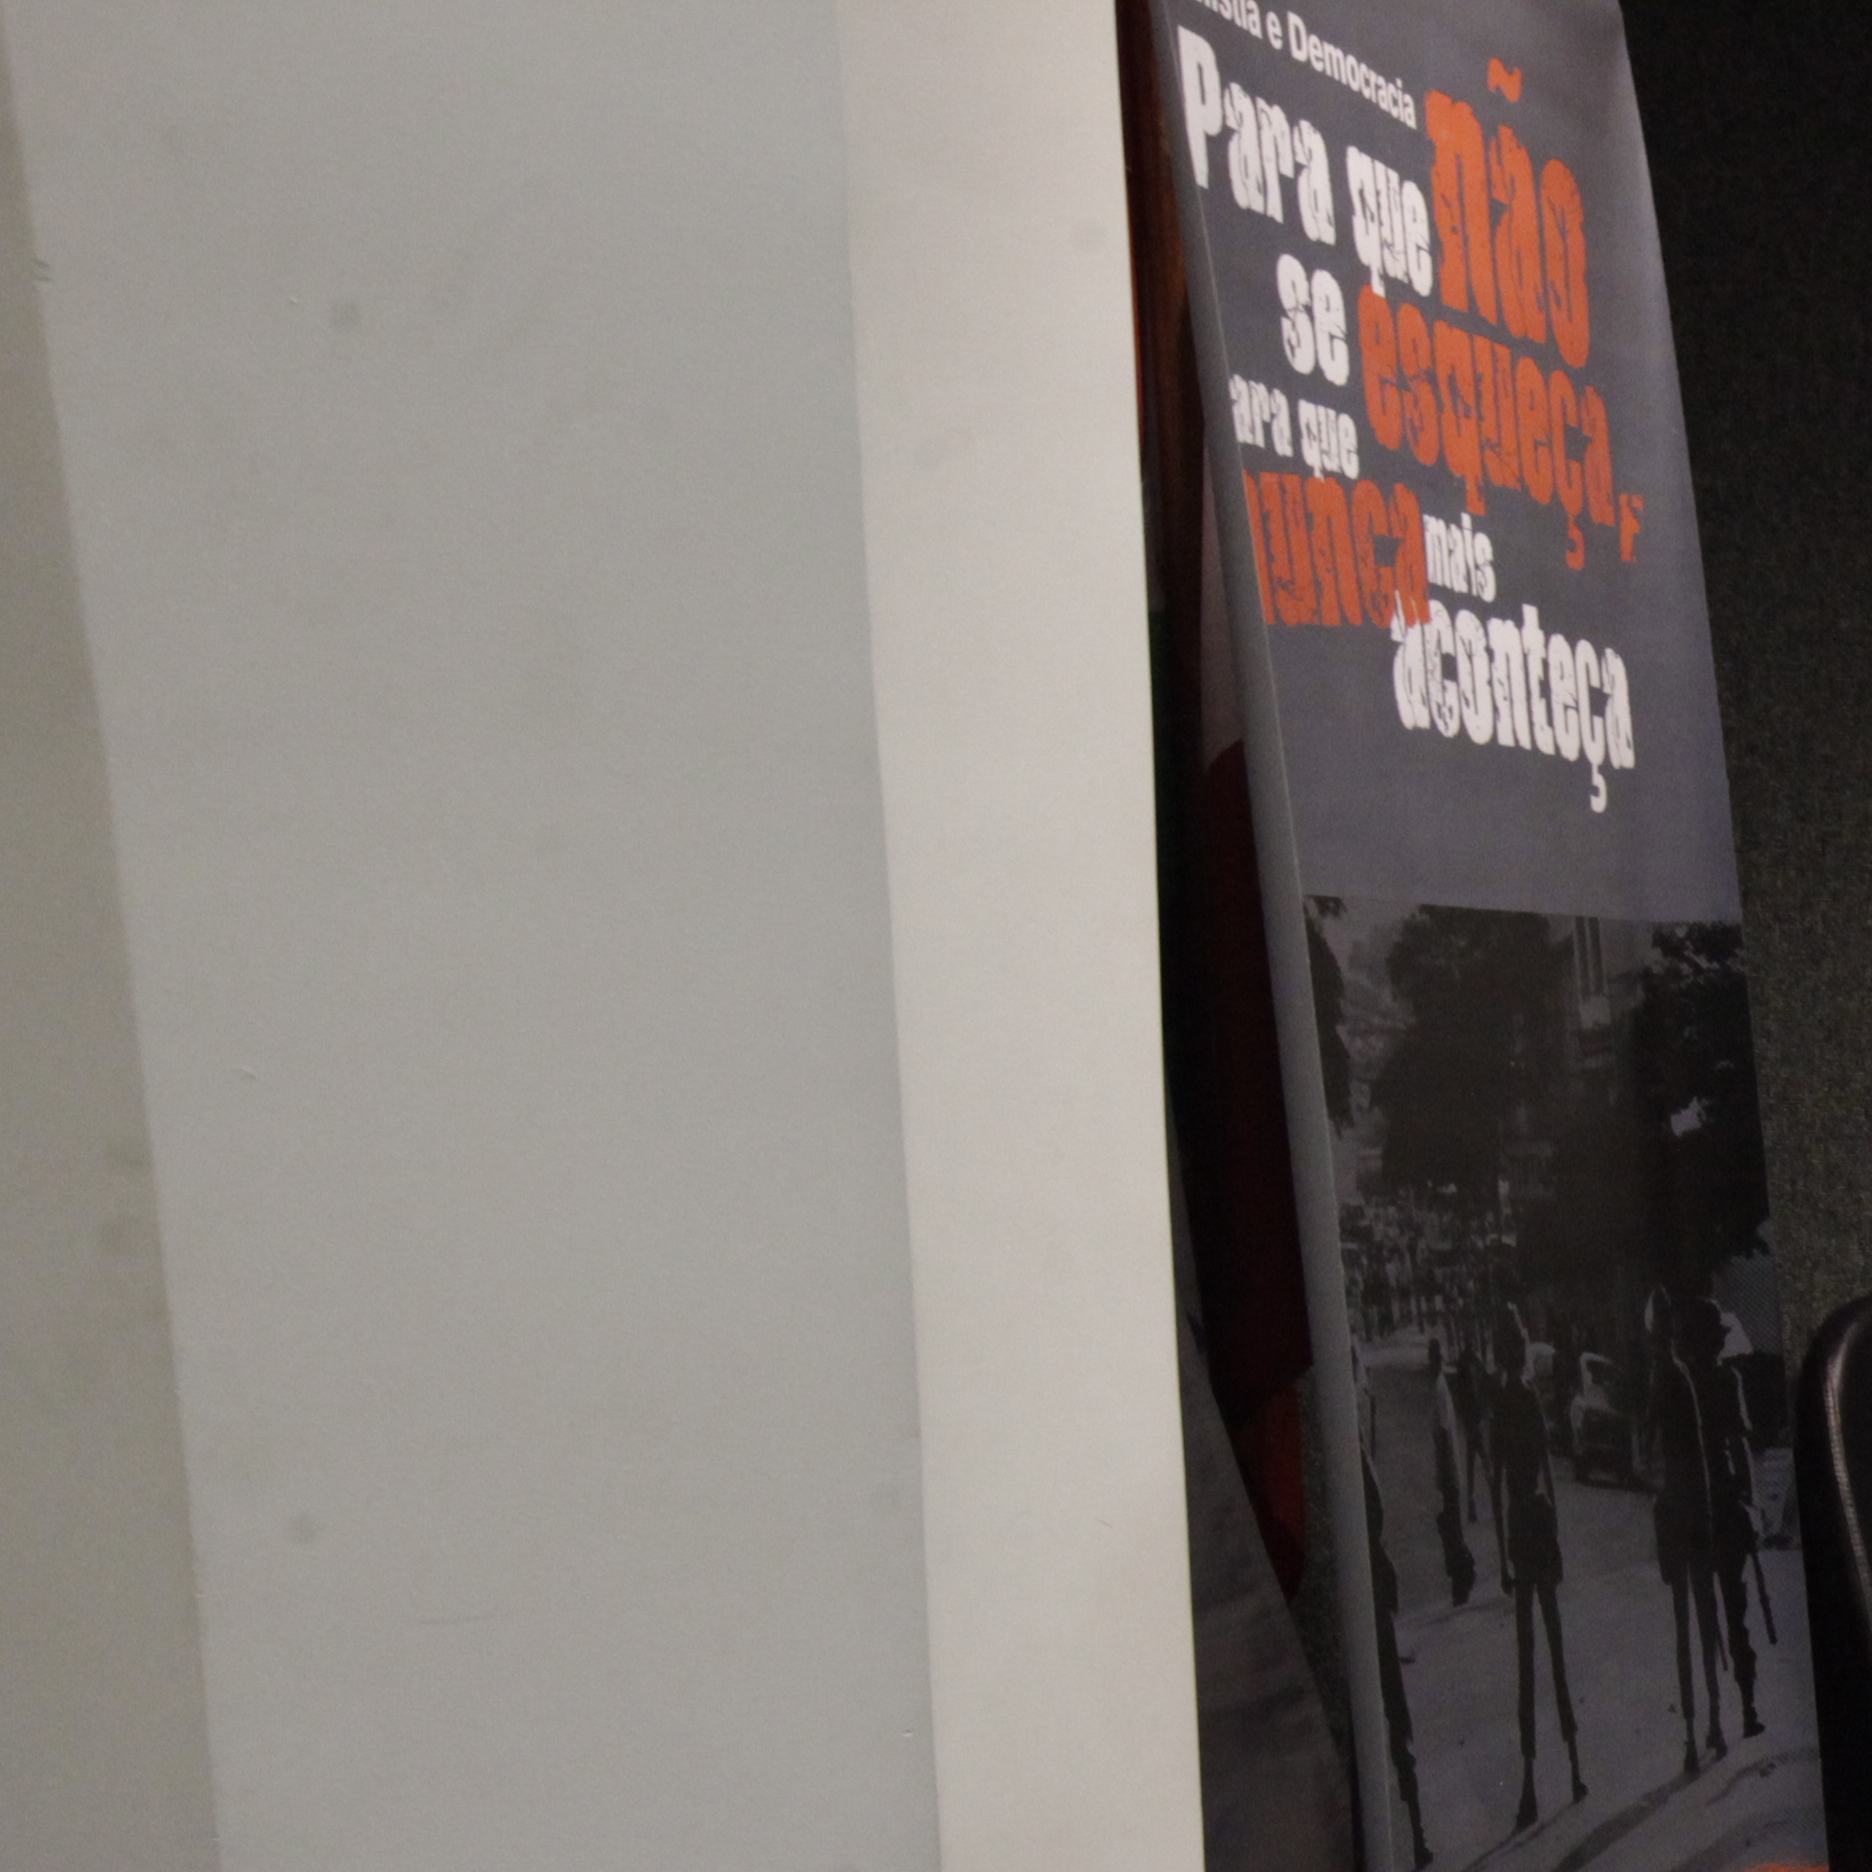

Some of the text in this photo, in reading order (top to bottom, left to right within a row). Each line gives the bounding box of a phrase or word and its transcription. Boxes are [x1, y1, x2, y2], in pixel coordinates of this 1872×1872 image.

[1266, 11, 1283, 50] e
[1287, 10, 1417, 129] Democracia
[1178, 25, 1590, 369] Para que não
[1276, 253, 1349, 386] se
[1229, 374, 1360, 482] ara que
[1423, 511, 1496, 603] mais
[1390, 590, 1636, 814] aconteça
